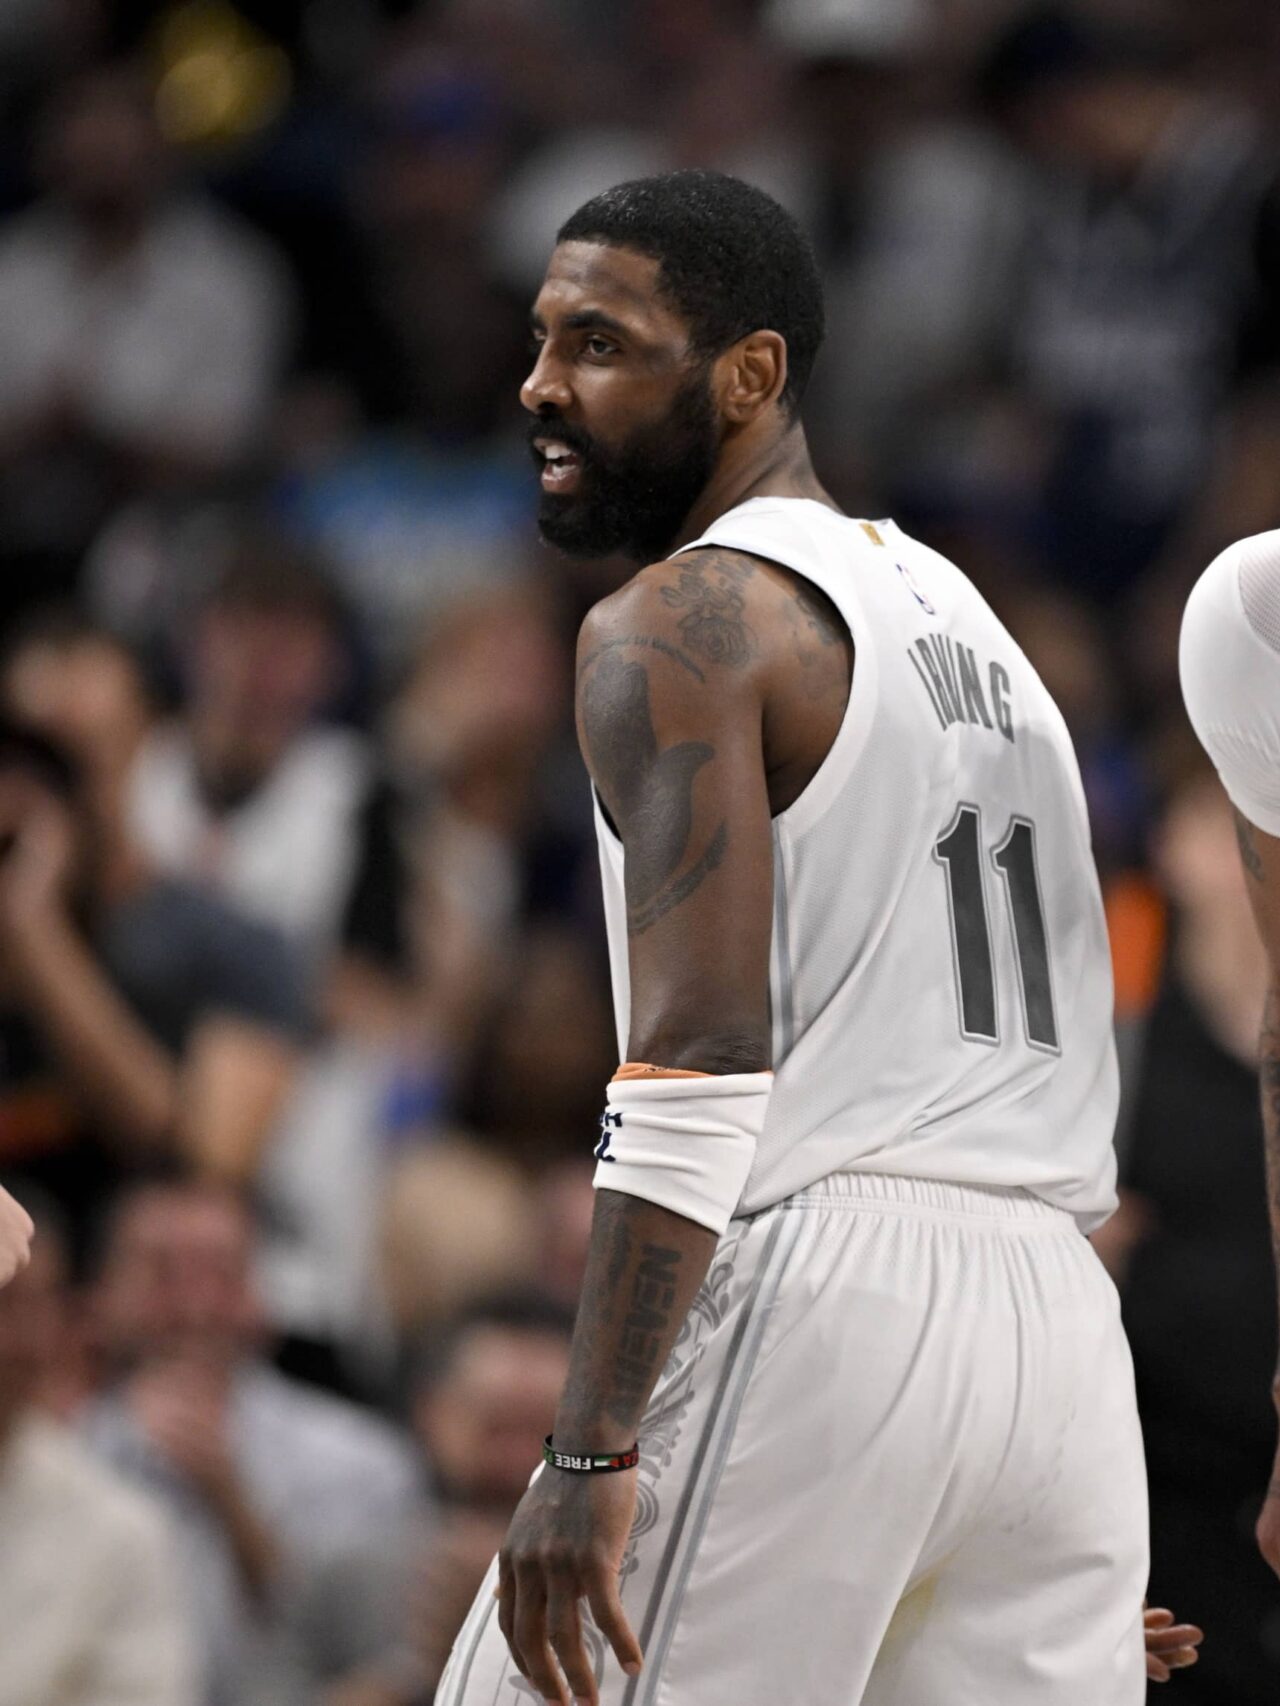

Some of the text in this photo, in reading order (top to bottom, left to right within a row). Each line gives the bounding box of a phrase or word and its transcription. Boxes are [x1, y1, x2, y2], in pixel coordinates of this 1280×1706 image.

[907, 633, 1015, 744] IRVING
[931, 800, 1062, 1058] 11
[554, 1453, 592, 1471] FREE
